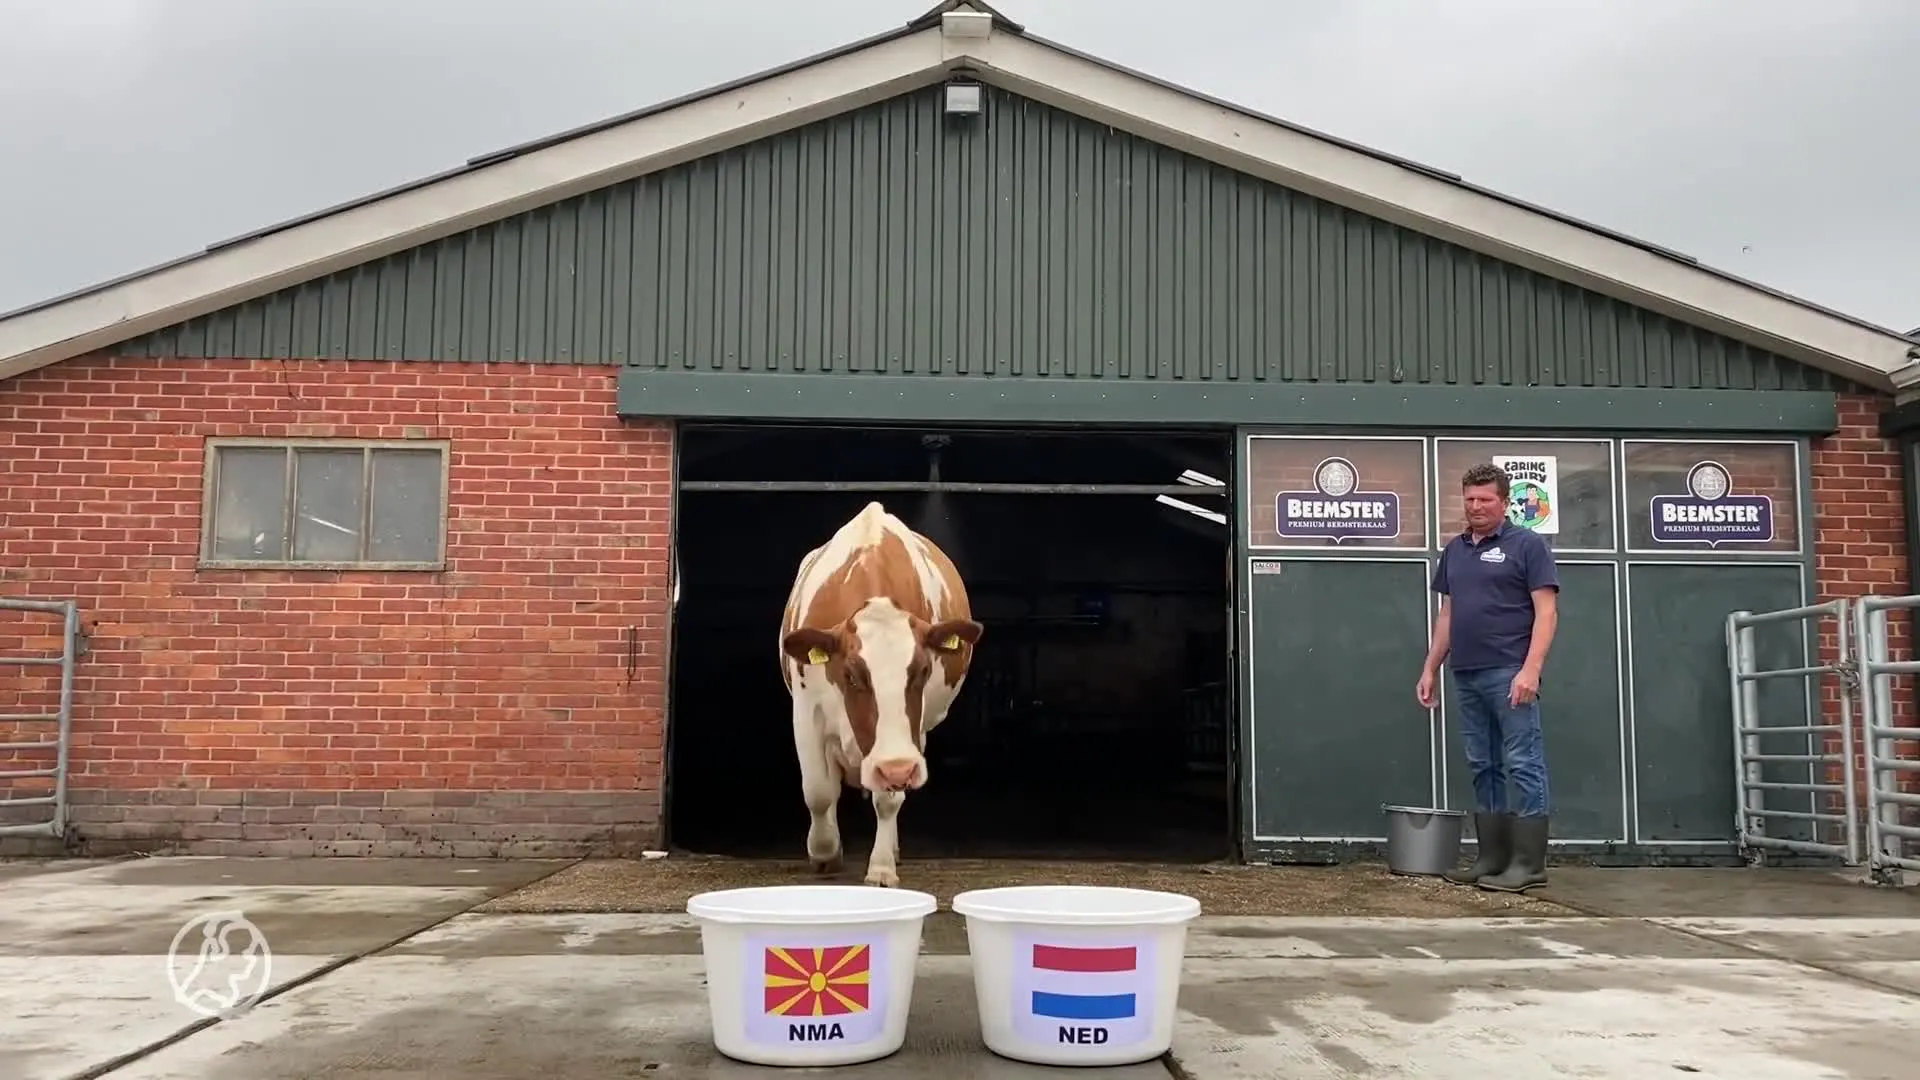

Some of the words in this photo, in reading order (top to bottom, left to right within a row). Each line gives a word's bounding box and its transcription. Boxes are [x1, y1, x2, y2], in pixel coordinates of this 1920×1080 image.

[1287, 499, 1386, 519] BEEMSTER
[1662, 503, 1760, 522] BEEMSTER
[1327, 521, 1387, 529] BEEMSTERKAAS
[789, 1023, 844, 1041] NMA
[1059, 1026, 1108, 1044] NED
